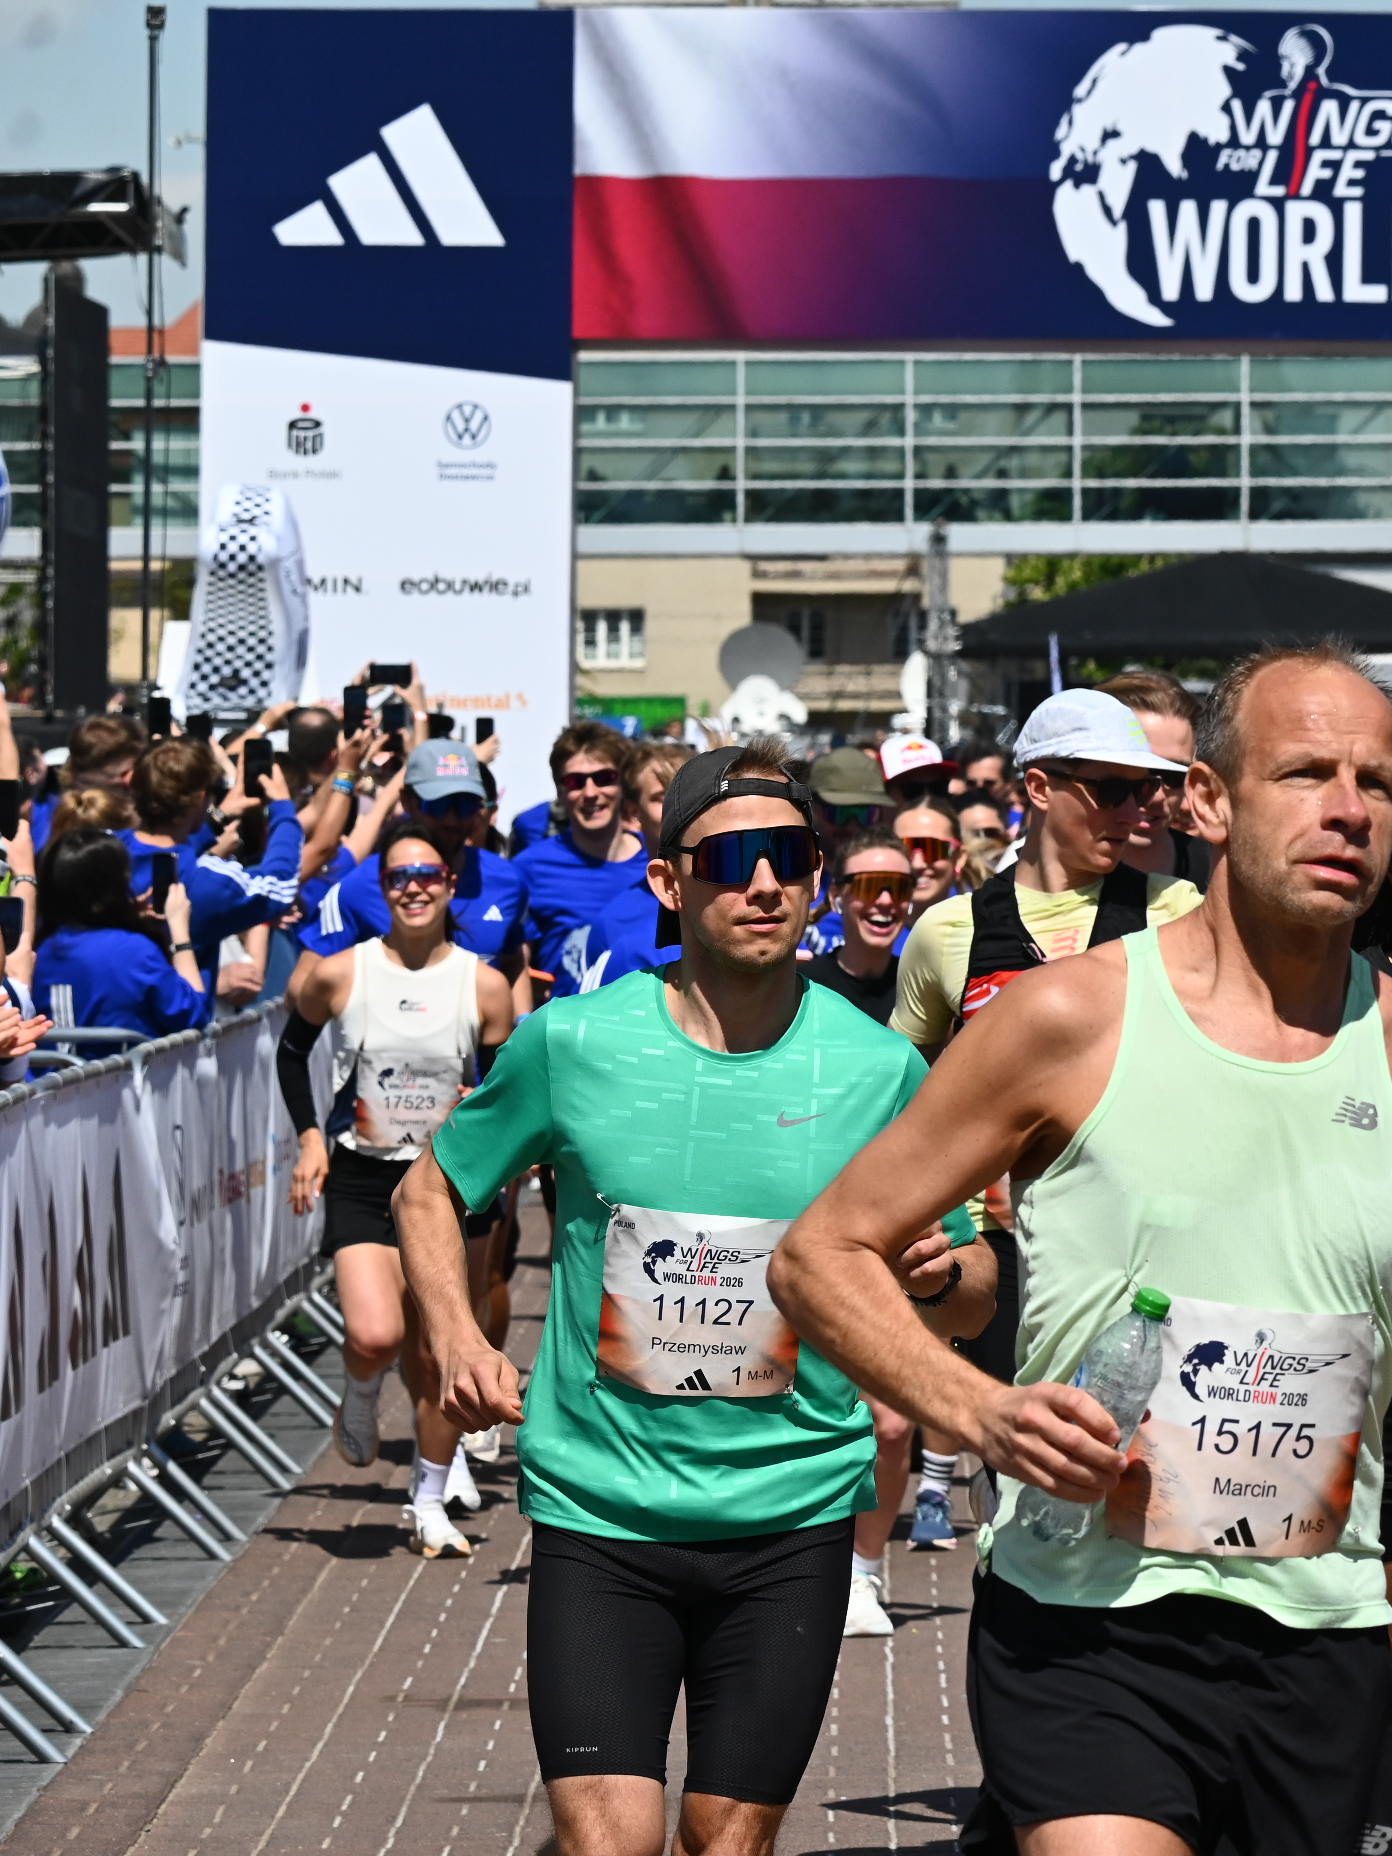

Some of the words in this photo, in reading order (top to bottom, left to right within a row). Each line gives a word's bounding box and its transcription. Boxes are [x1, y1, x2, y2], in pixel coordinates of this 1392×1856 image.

[1217, 149, 1262, 172] FOR
[1254, 149, 1378, 197] LIFE
[305, 576, 365, 596] MIN
[400, 573, 532, 600] eobuwie.pl
[384, 1095, 436, 1110] 17523
[613, 1219, 636, 1230] POLAND
[675, 1258, 689, 1266] FOR
[680, 1245, 742, 1263] WINGS
[685, 1261, 723, 1274] LIFE
[662, 1272, 696, 1285] WORLD
[697, 1275, 717, 1287] RUN
[719, 1276, 744, 1288] 2026
[652, 1293, 755, 1327] 11127
[651, 1336, 747, 1358] Przemysław
[1233, 1349, 1309, 1372] WINGS
[731, 1365, 742, 1386] 1
[747, 1369, 774, 1381] M-M
[1225, 1367, 1243, 1376] FOR
[1239, 1370, 1286, 1388] LIFE
[1207, 1384, 1250, 1403] WORLD
[1252, 1391, 1277, 1405] RUN
[1279, 1392, 1308, 1407] 2026
[1190, 1414, 1317, 1459] 15175
[1212, 1476, 1277, 1498] Marcin
[1281, 1512, 1293, 1541] 1
[1298, 1518, 1325, 1534] M-S
